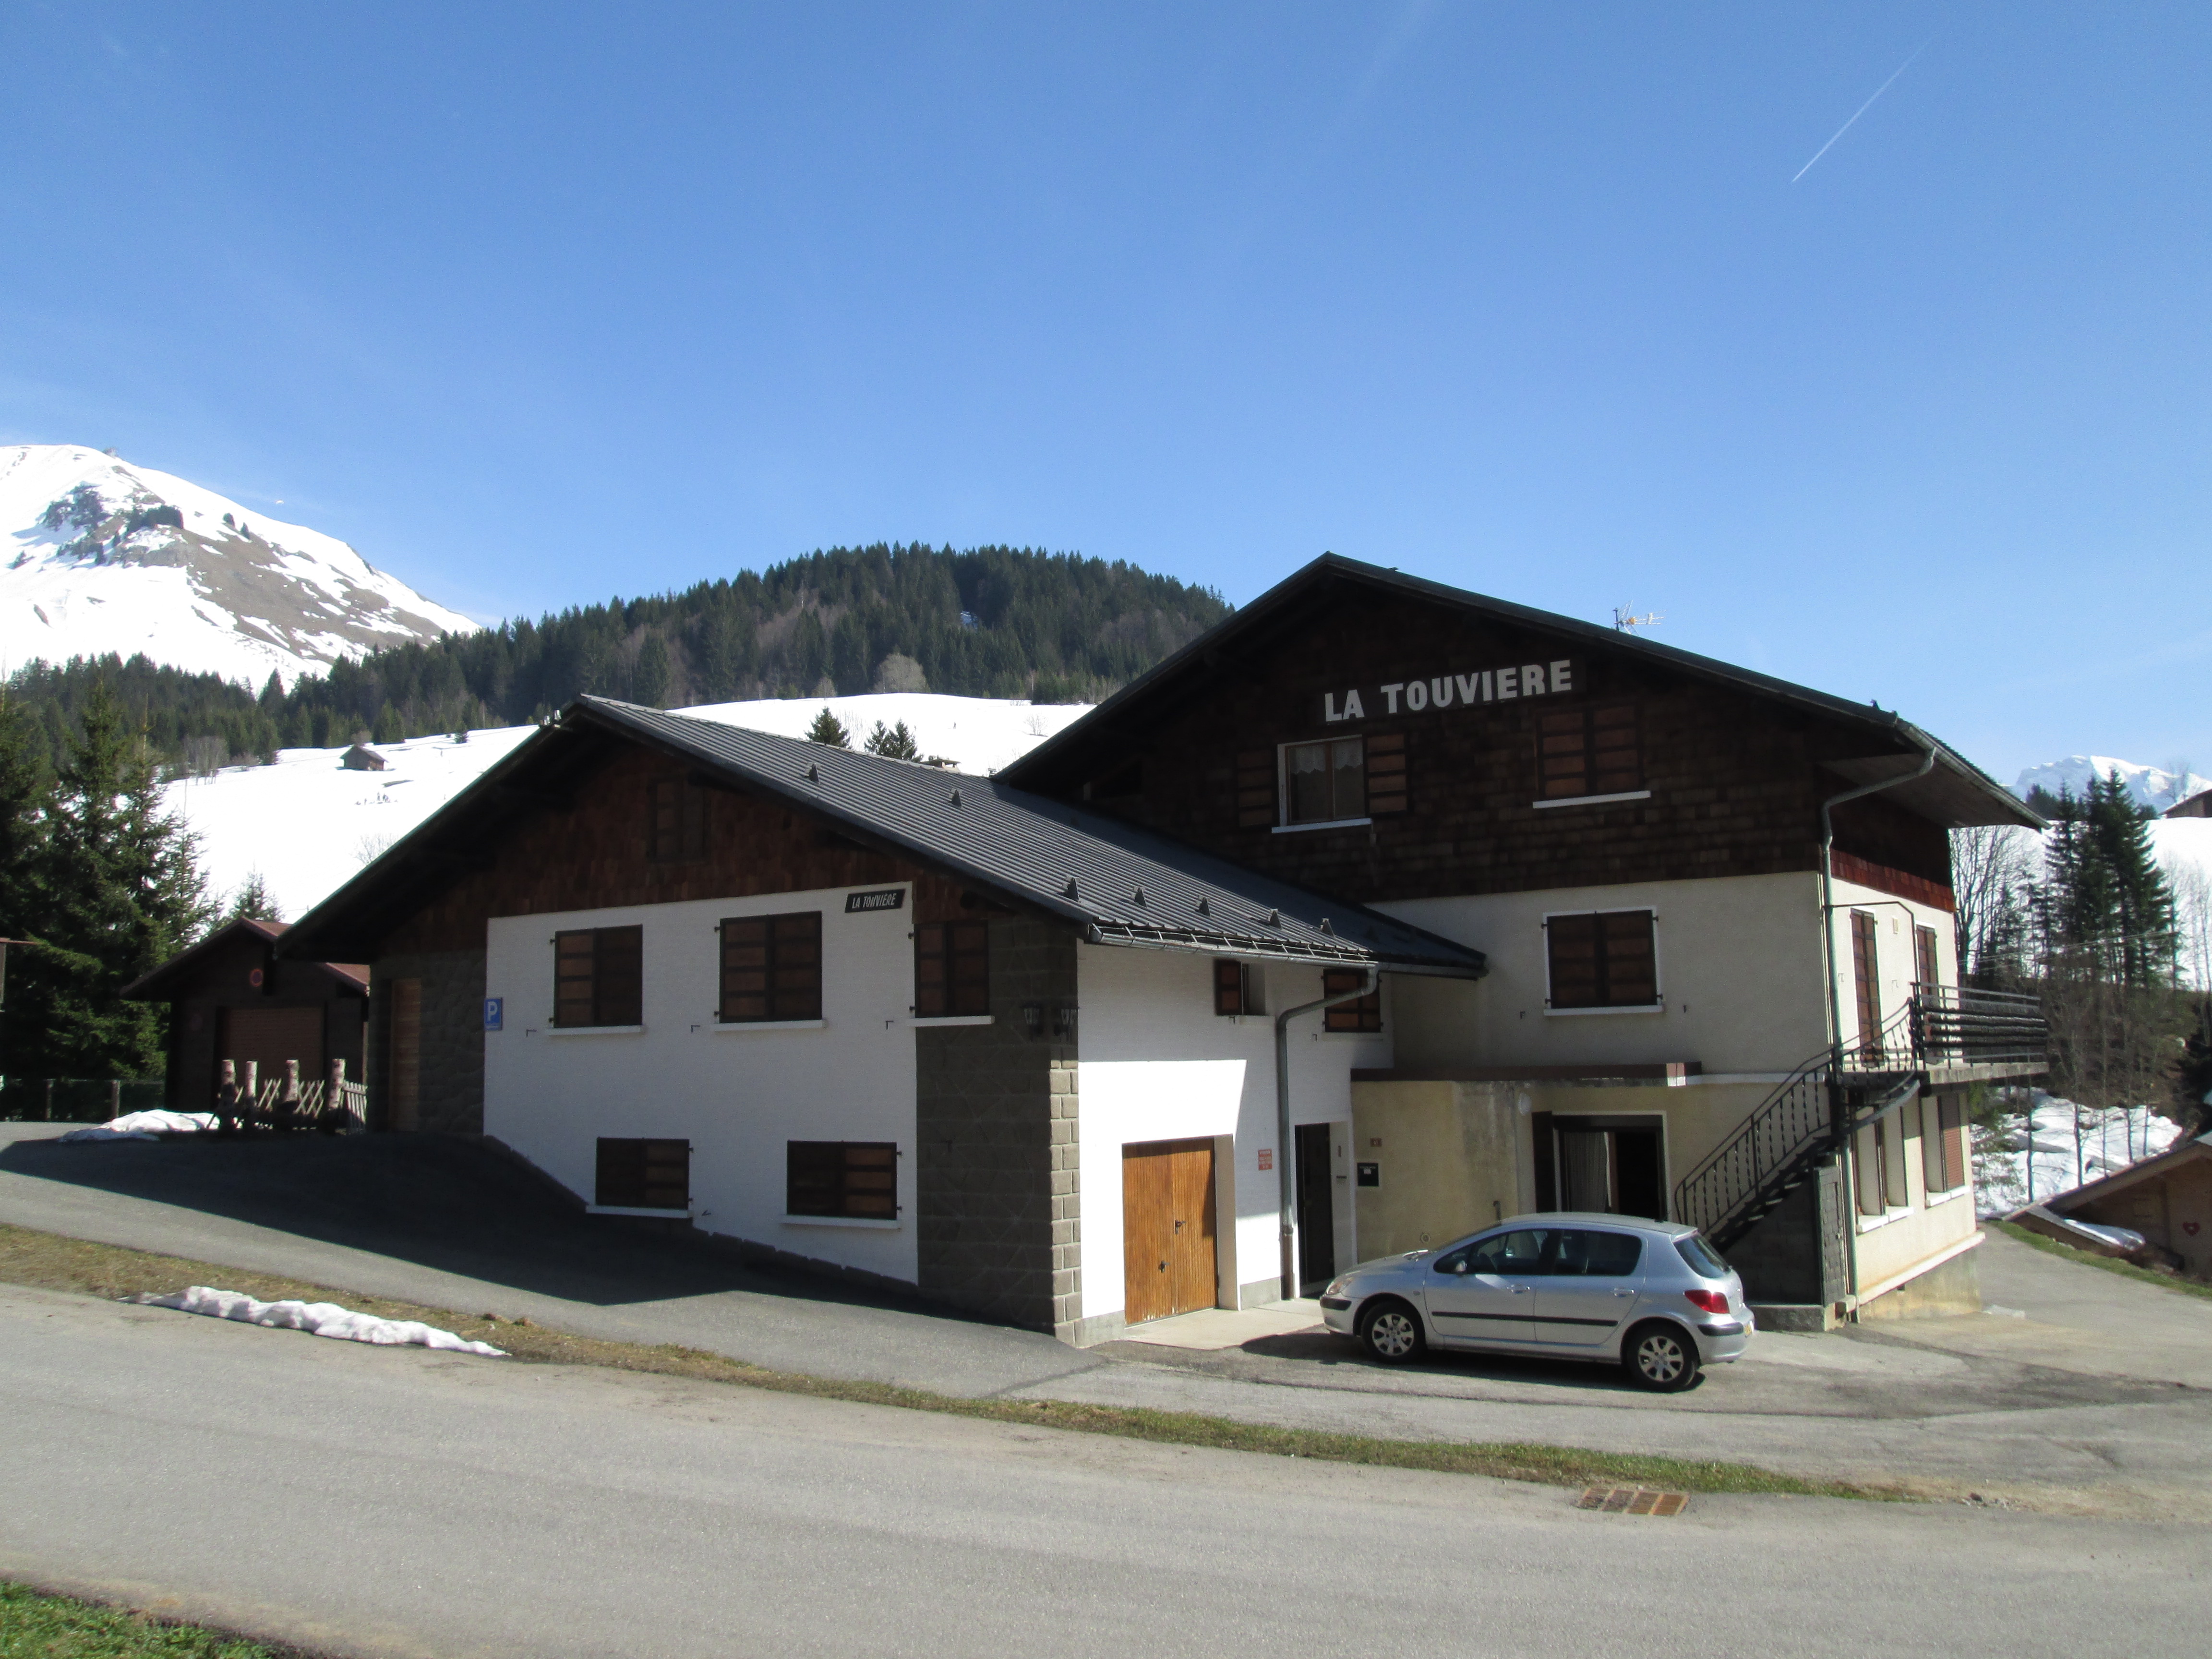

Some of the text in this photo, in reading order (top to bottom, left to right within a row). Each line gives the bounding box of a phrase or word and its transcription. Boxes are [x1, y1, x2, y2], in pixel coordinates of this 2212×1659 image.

[1324, 659, 1572, 722] LA TOUVIERE
[852, 897, 861, 909] LA
[487, 1001, 498, 1022] P
